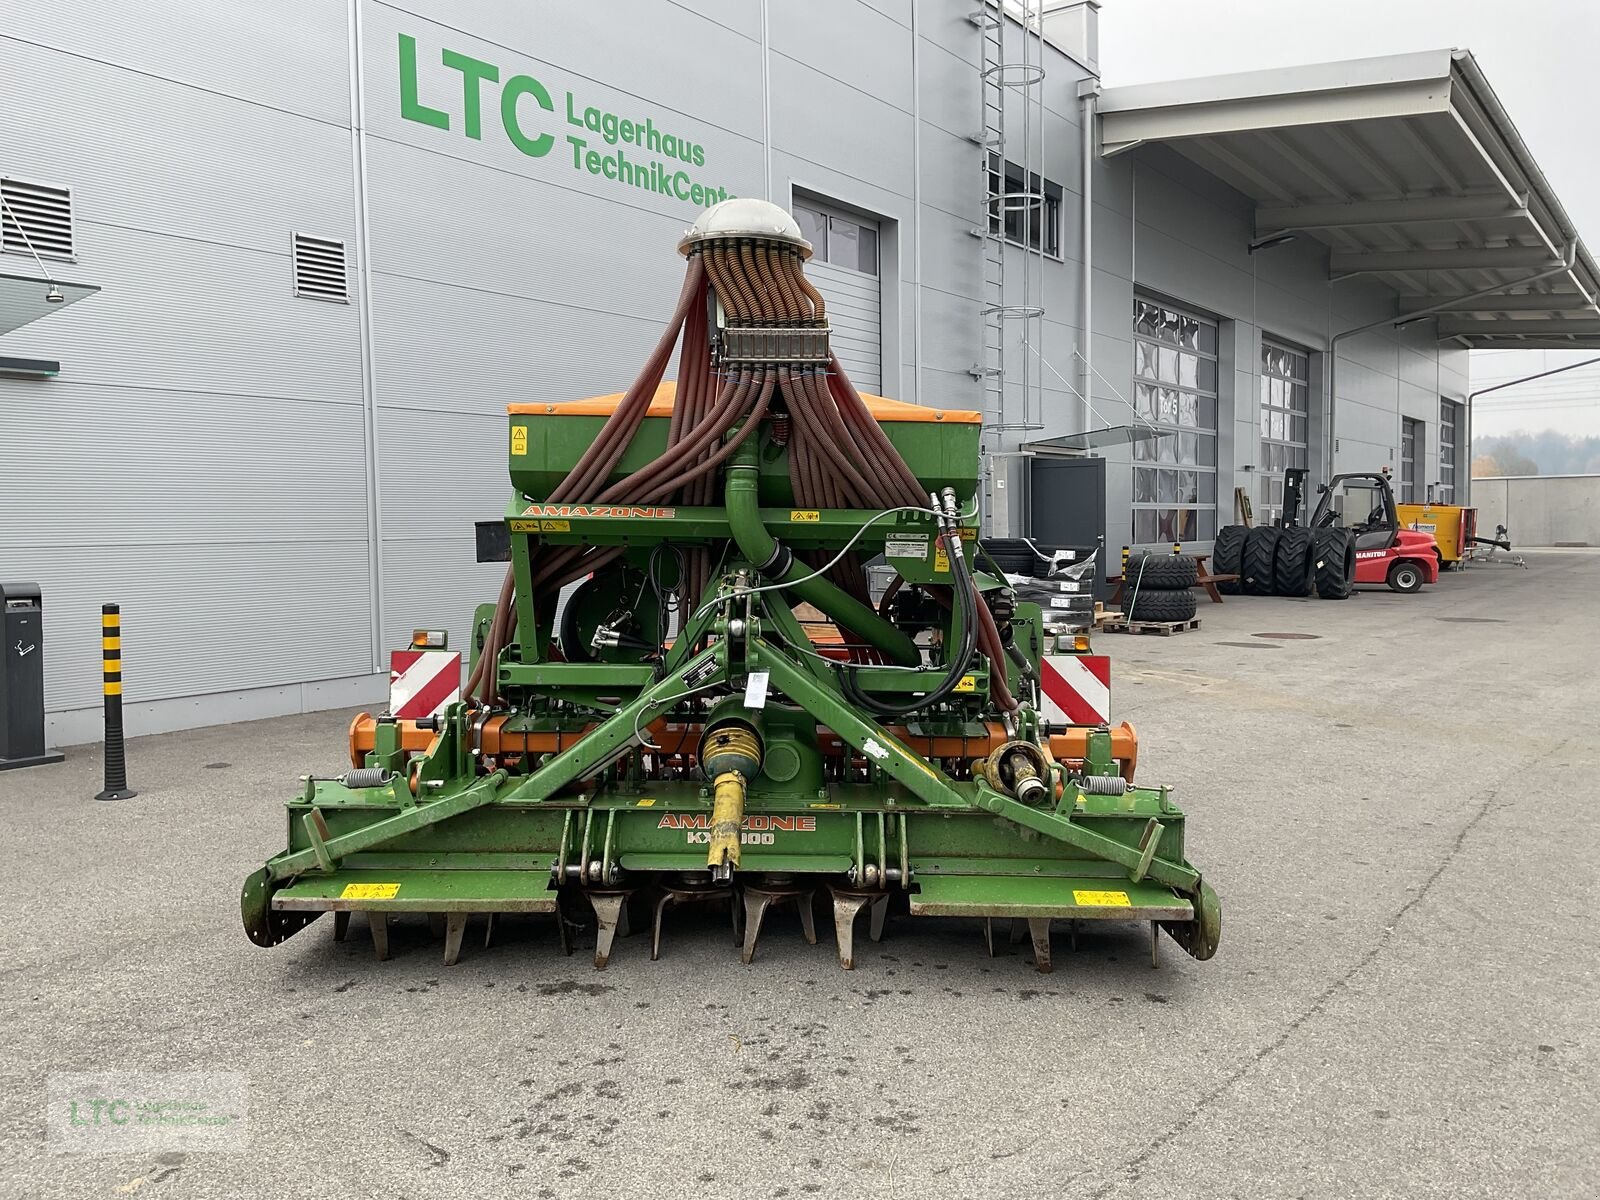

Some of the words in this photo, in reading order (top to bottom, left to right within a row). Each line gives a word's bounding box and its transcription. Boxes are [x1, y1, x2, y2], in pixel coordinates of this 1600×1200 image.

[398, 32, 555, 159] LTC
[566, 91, 706, 168] Lagerhaus
[566, 135, 738, 209] TechnikCent
[521, 505, 676, 519] AMAZONE
[1355, 550, 1387, 559] MANITOU
